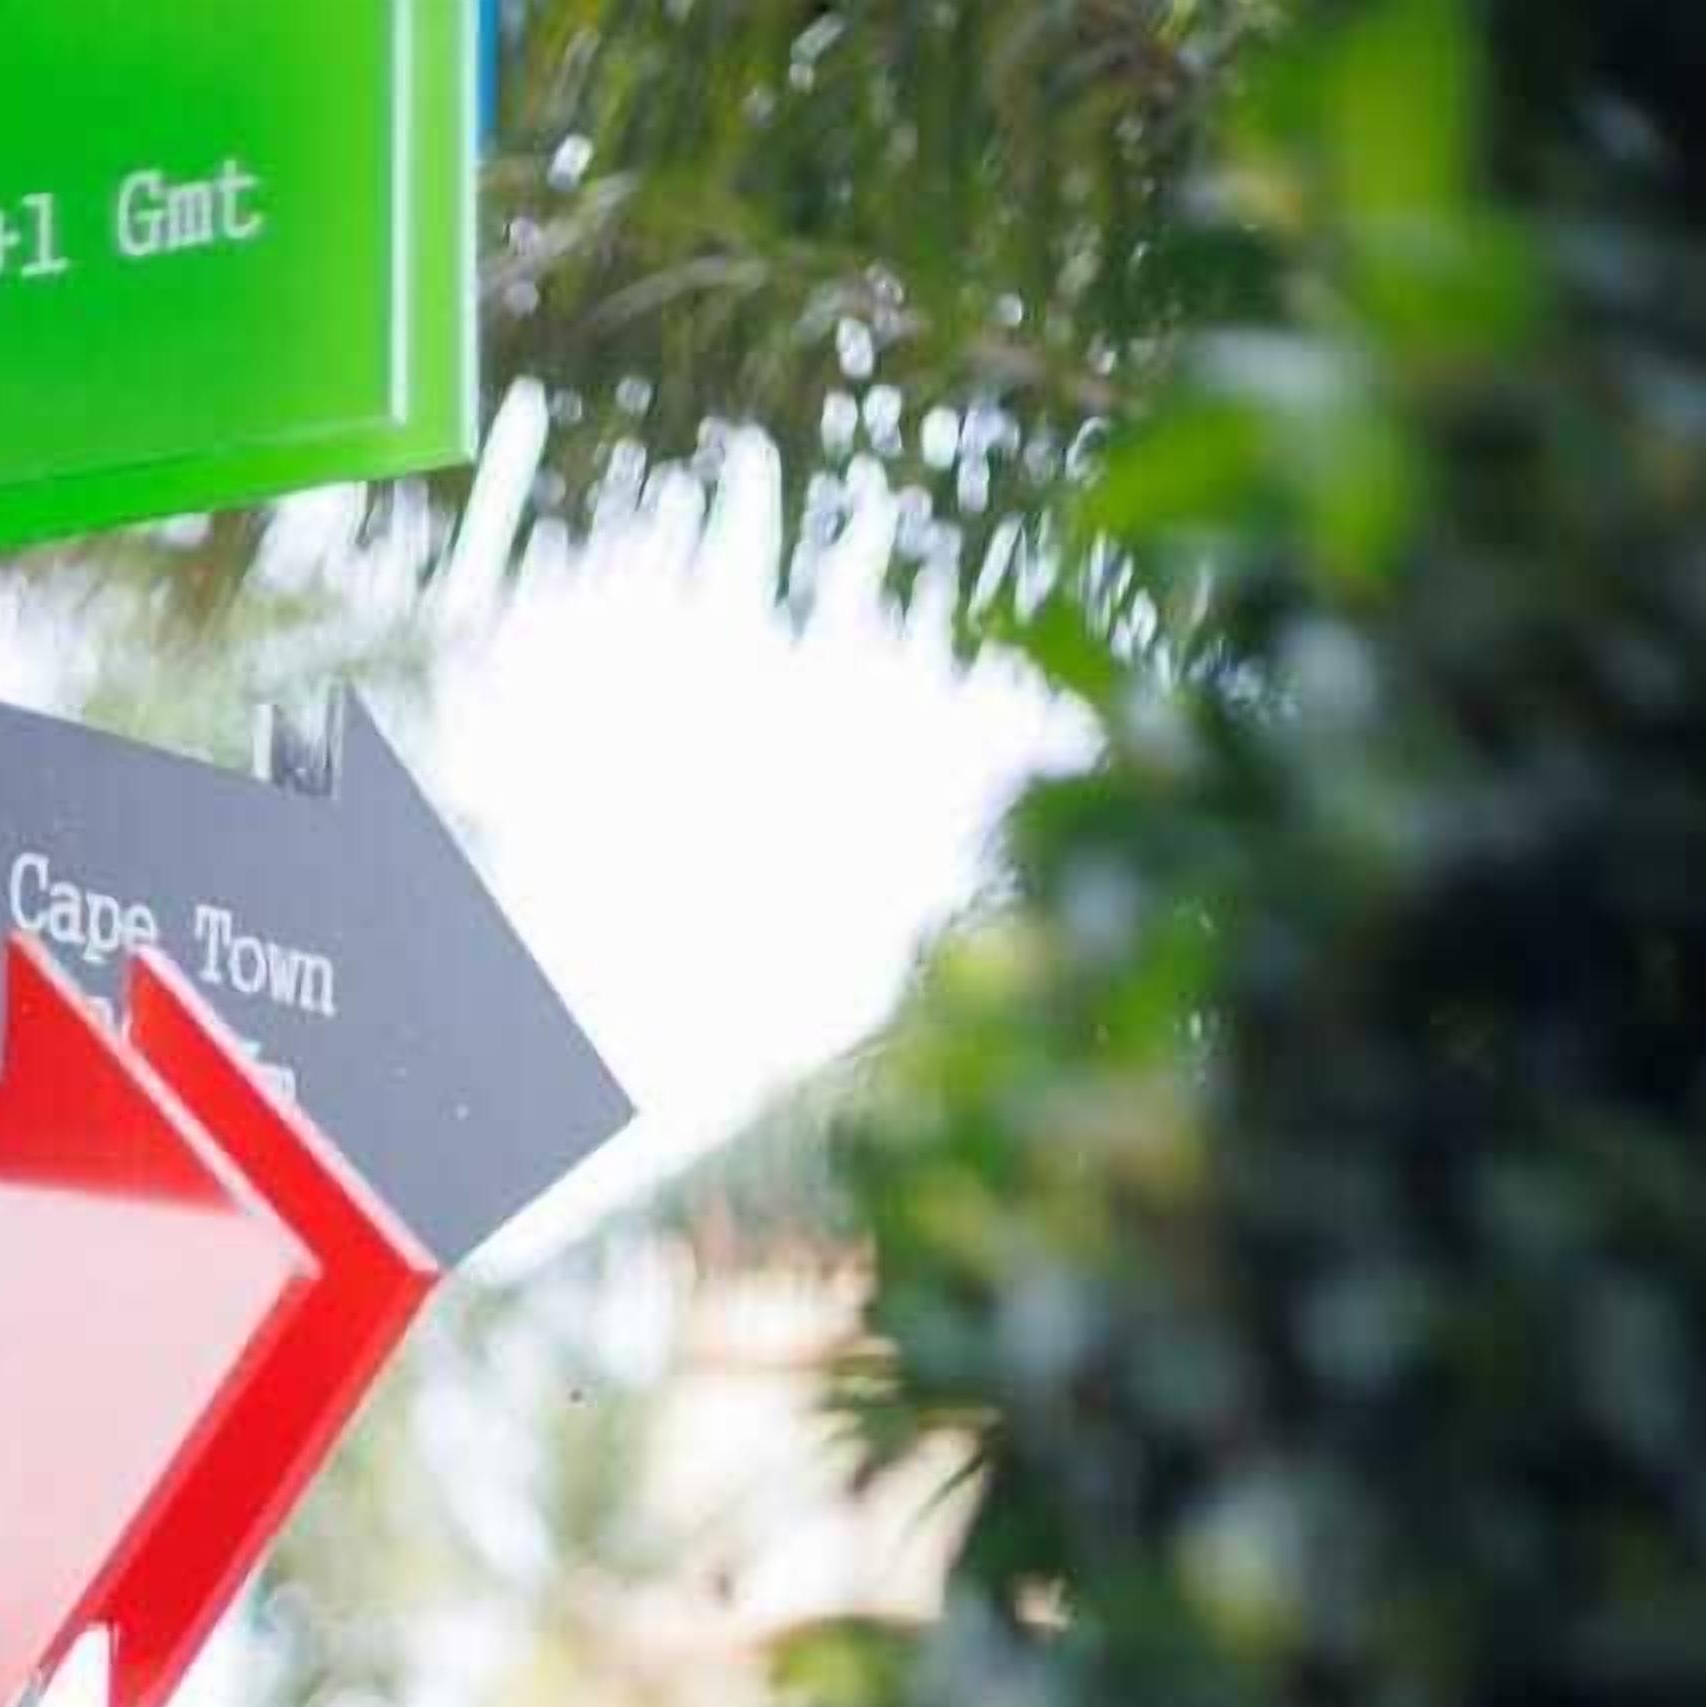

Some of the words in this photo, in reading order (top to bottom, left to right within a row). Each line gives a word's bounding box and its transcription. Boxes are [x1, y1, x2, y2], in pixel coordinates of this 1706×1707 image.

[117, 158, 264, 257] Gmt
[9, 852, 159, 964] Cape
[194, 904, 336, 1017] Town
